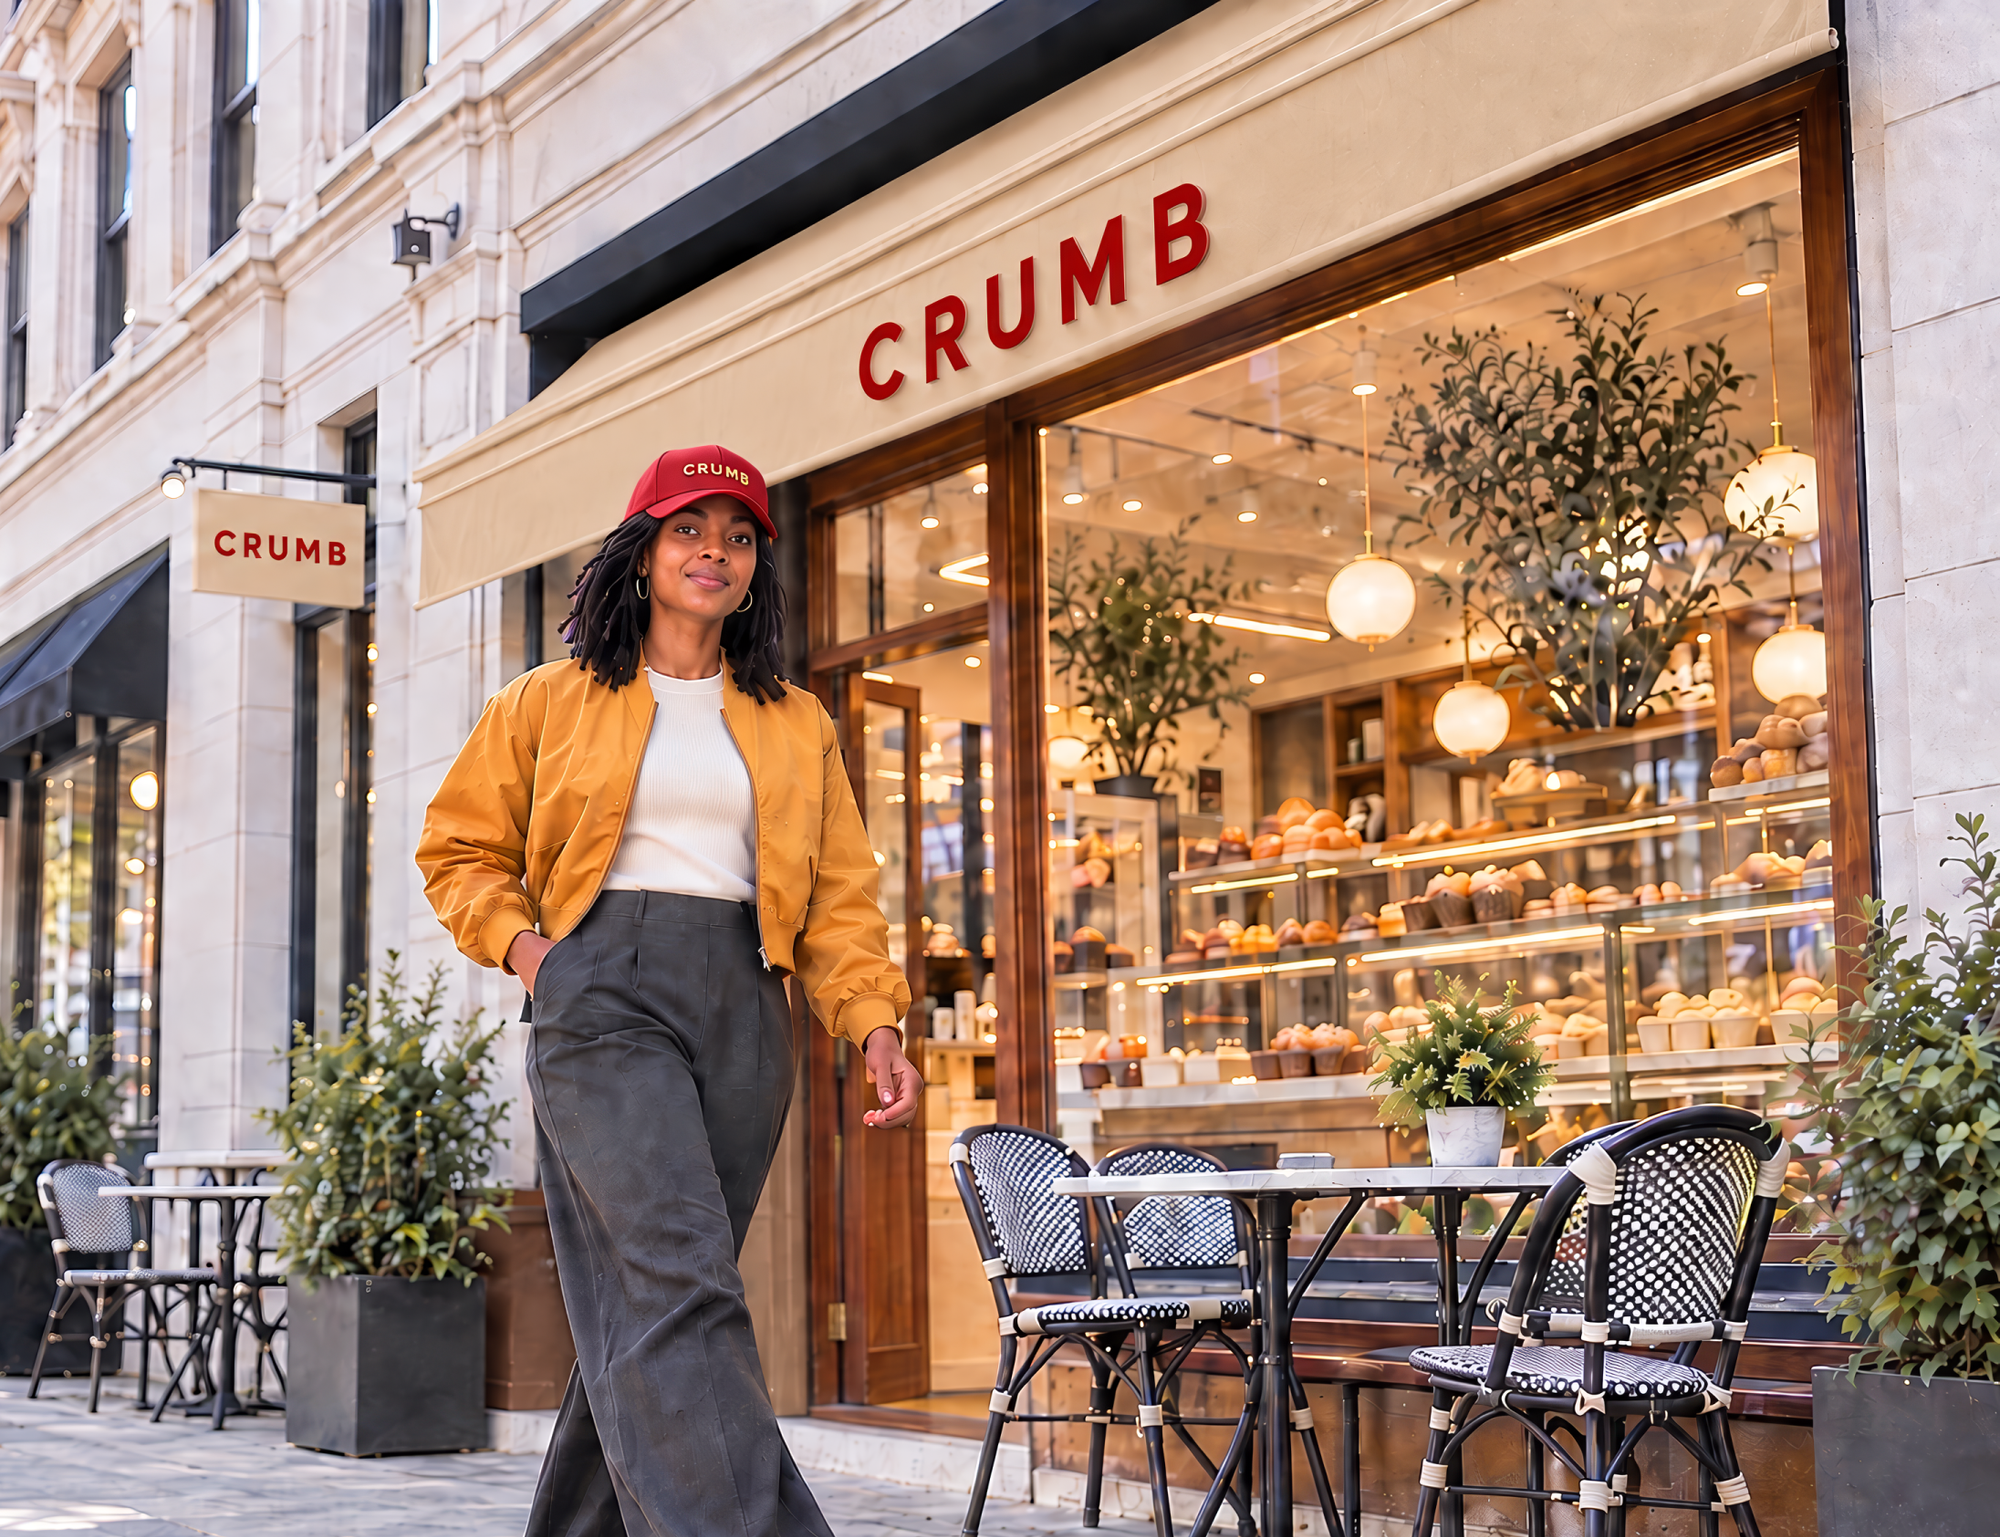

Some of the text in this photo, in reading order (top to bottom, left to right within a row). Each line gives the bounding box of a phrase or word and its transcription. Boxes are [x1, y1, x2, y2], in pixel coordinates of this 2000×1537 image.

[858, 182, 1211, 401] CRUMB
[683, 462, 749, 486] CRUMB
[214, 529, 347, 566] CRUMB
